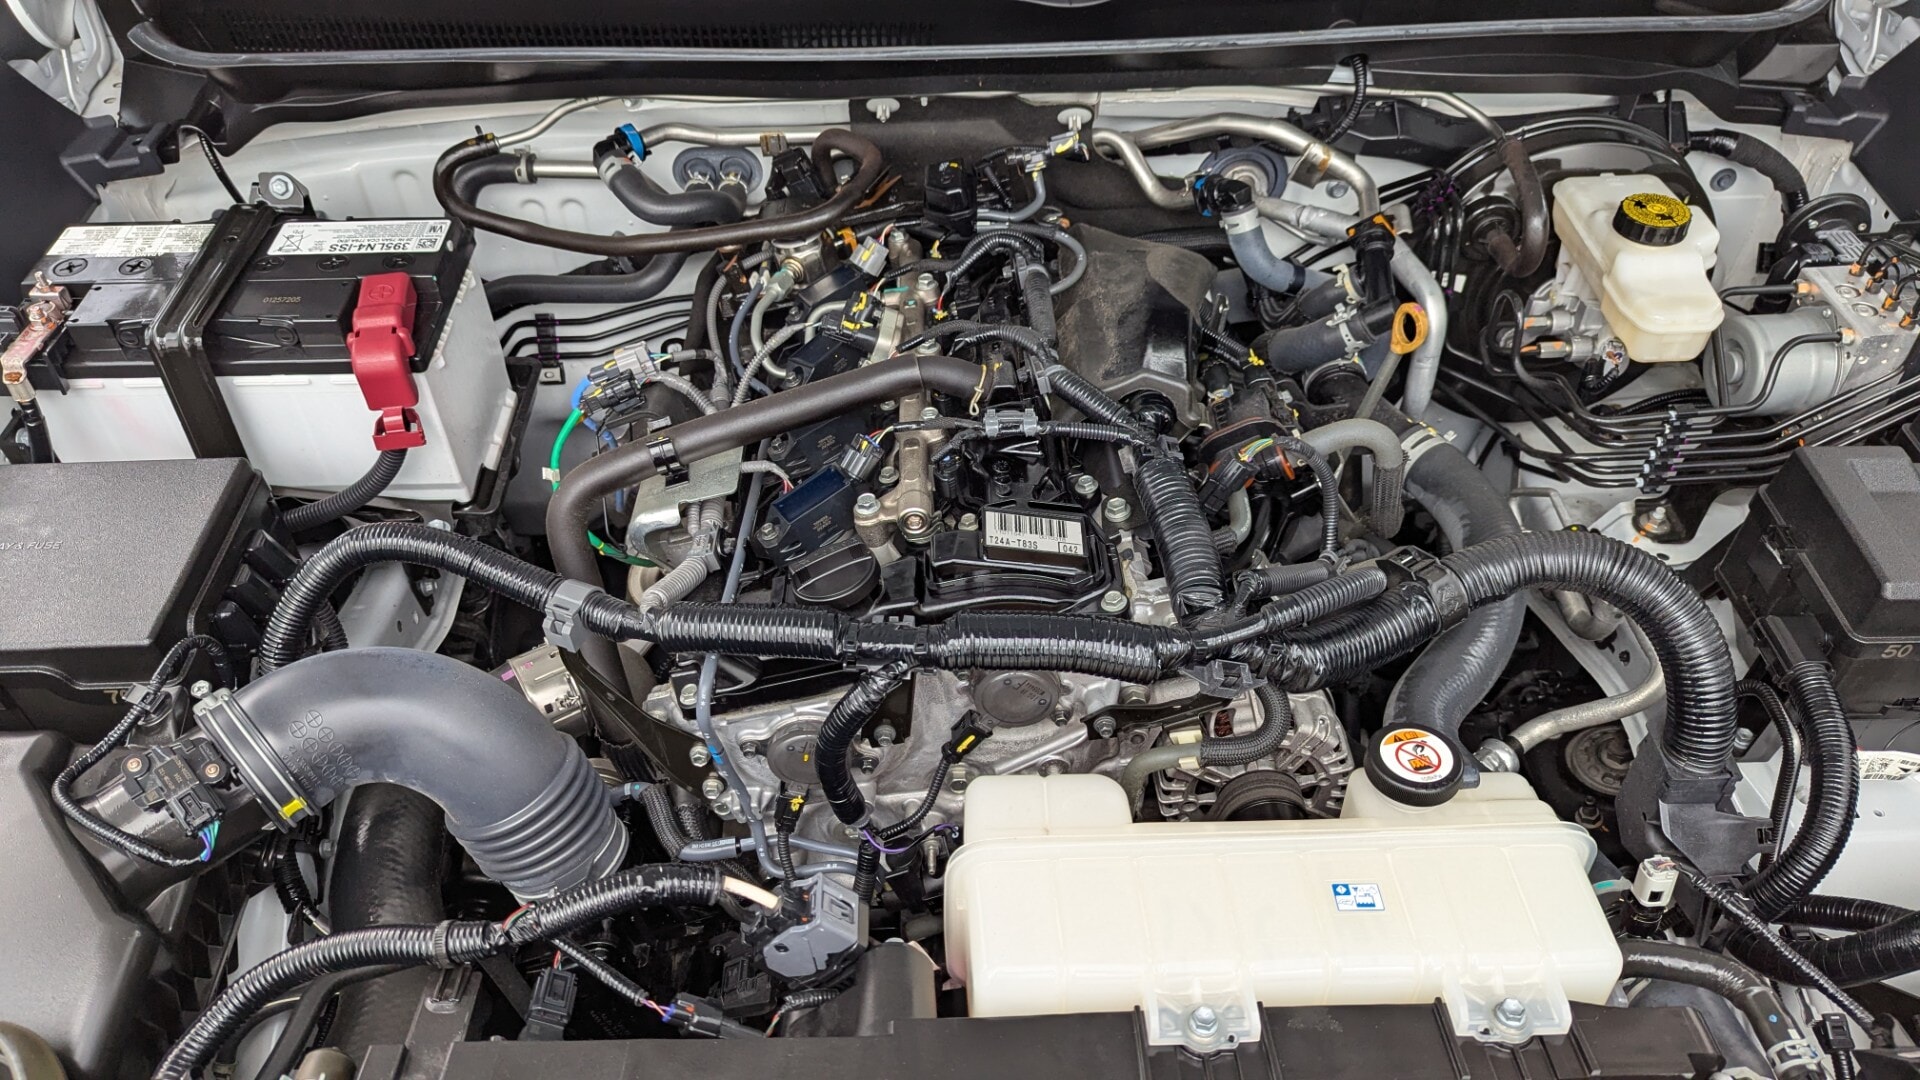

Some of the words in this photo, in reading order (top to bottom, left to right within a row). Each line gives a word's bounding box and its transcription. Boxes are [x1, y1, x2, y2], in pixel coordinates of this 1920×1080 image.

[429, 225, 443, 233] VM
[328, 242, 410, 253] 395LN4-ISS
[27, 540, 63, 550] FUSE
[989, 535, 1038, 550] T24A-T83S
[1062, 544, 1079, 554] 042
[1881, 644, 1913, 659] 50
